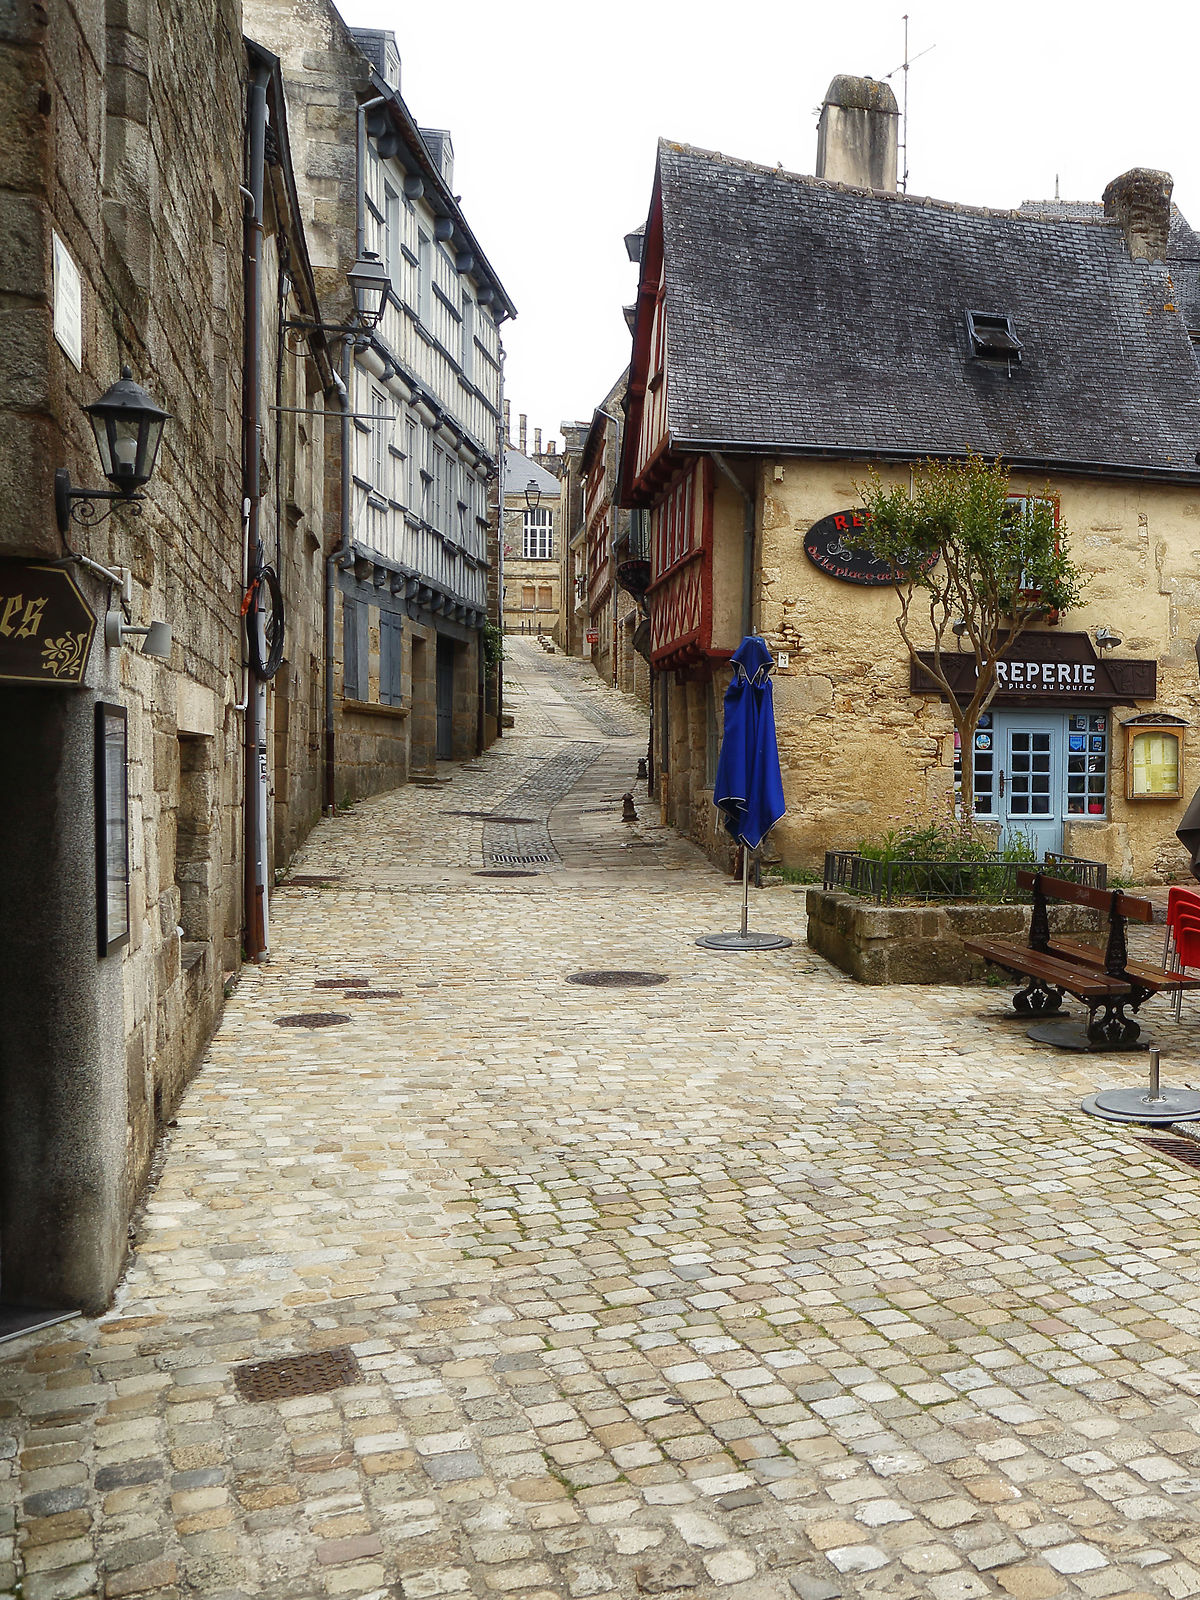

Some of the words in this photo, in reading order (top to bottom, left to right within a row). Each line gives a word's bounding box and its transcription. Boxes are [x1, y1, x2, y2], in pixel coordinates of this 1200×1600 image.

[0, 594, 48, 638] es
[1008, 682, 1037, 690] place
[1059, 683, 1095, 691] beurre
